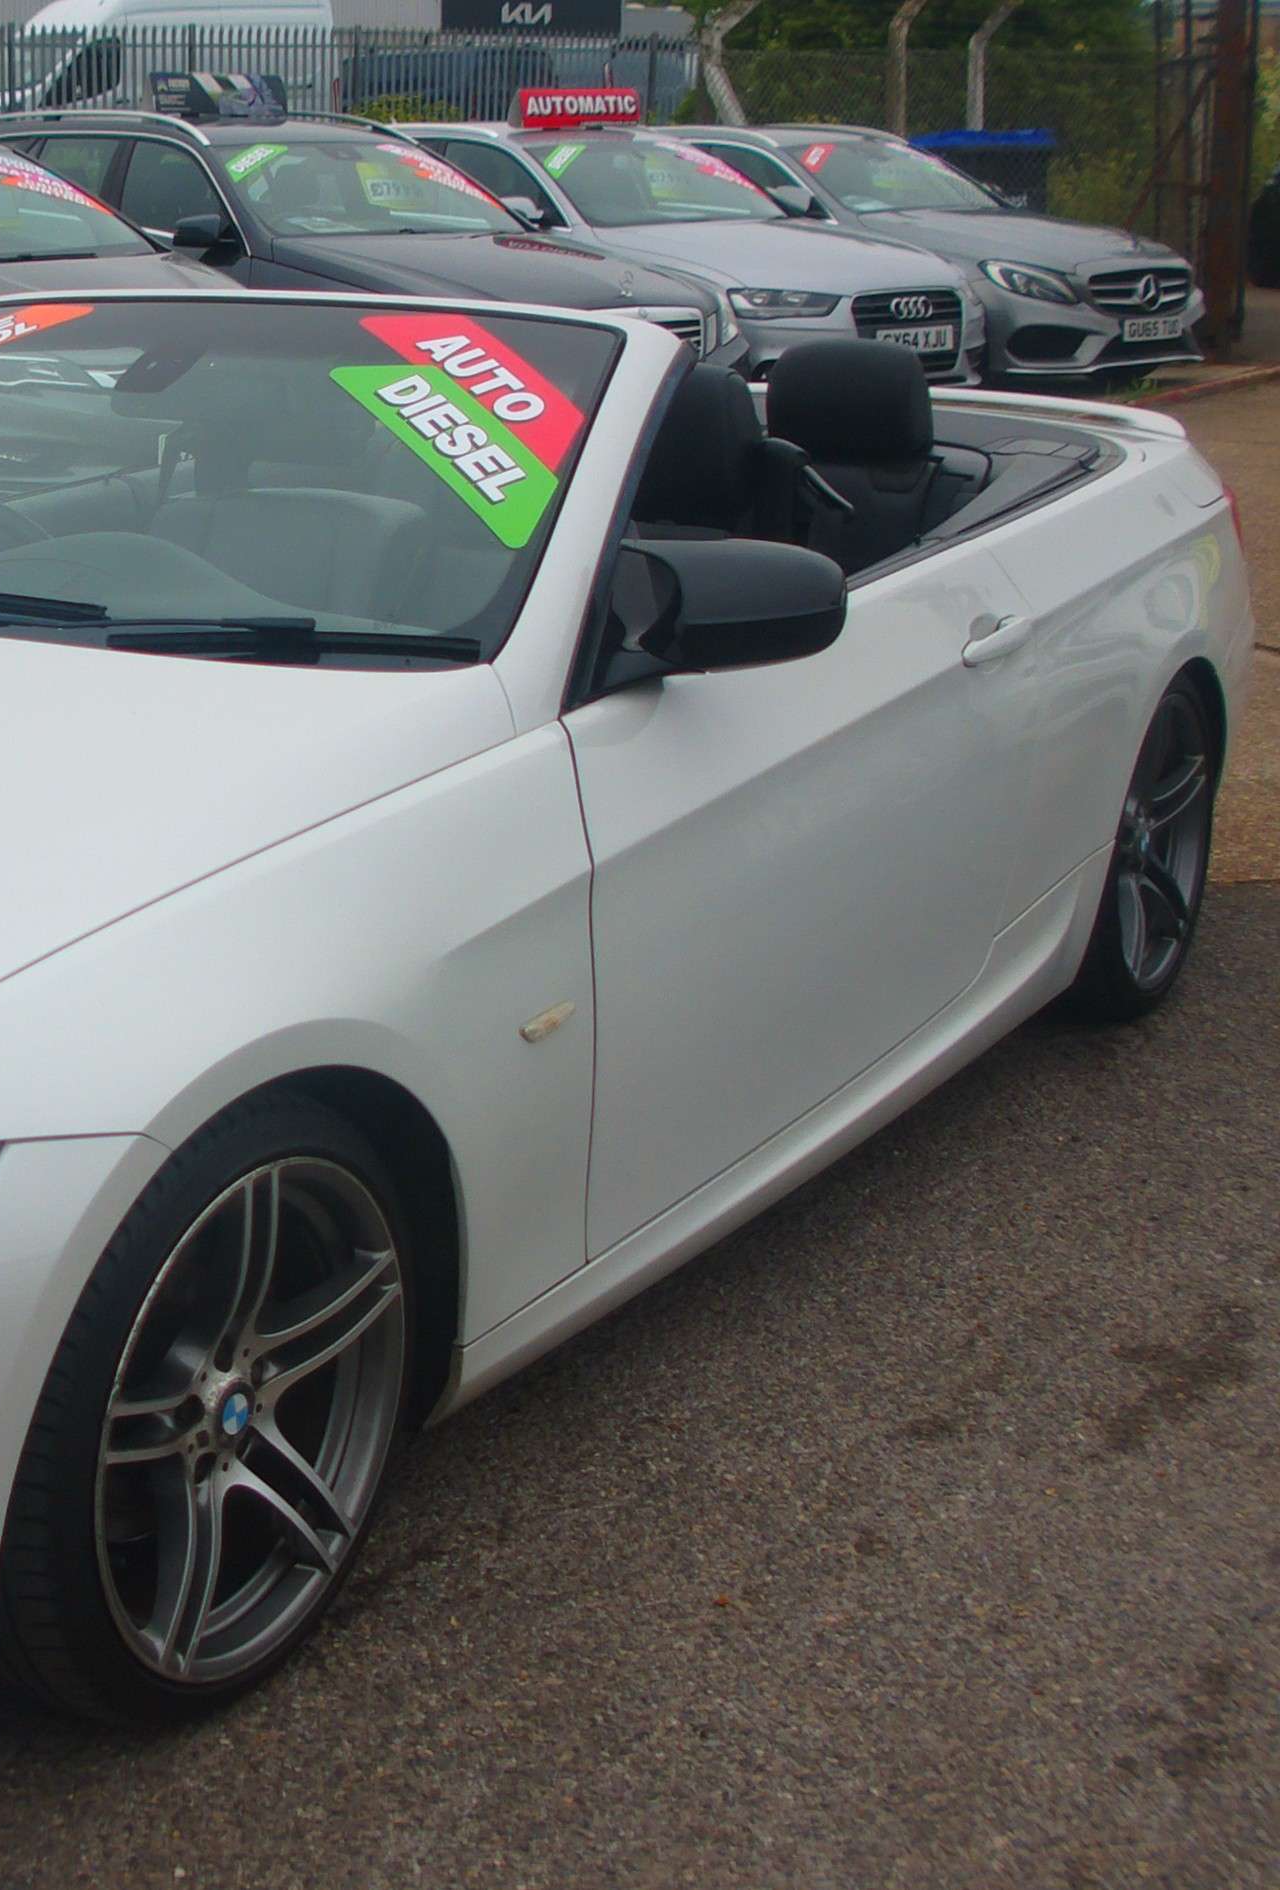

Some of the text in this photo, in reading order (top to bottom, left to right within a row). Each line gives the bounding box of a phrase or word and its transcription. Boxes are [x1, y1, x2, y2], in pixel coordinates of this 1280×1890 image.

[501, 2, 552, 25] KIA
[527, 95, 636, 115] AUTOMATIC
[415, 334, 546, 422] AUTO
[375, 373, 528, 504] DIESEL
